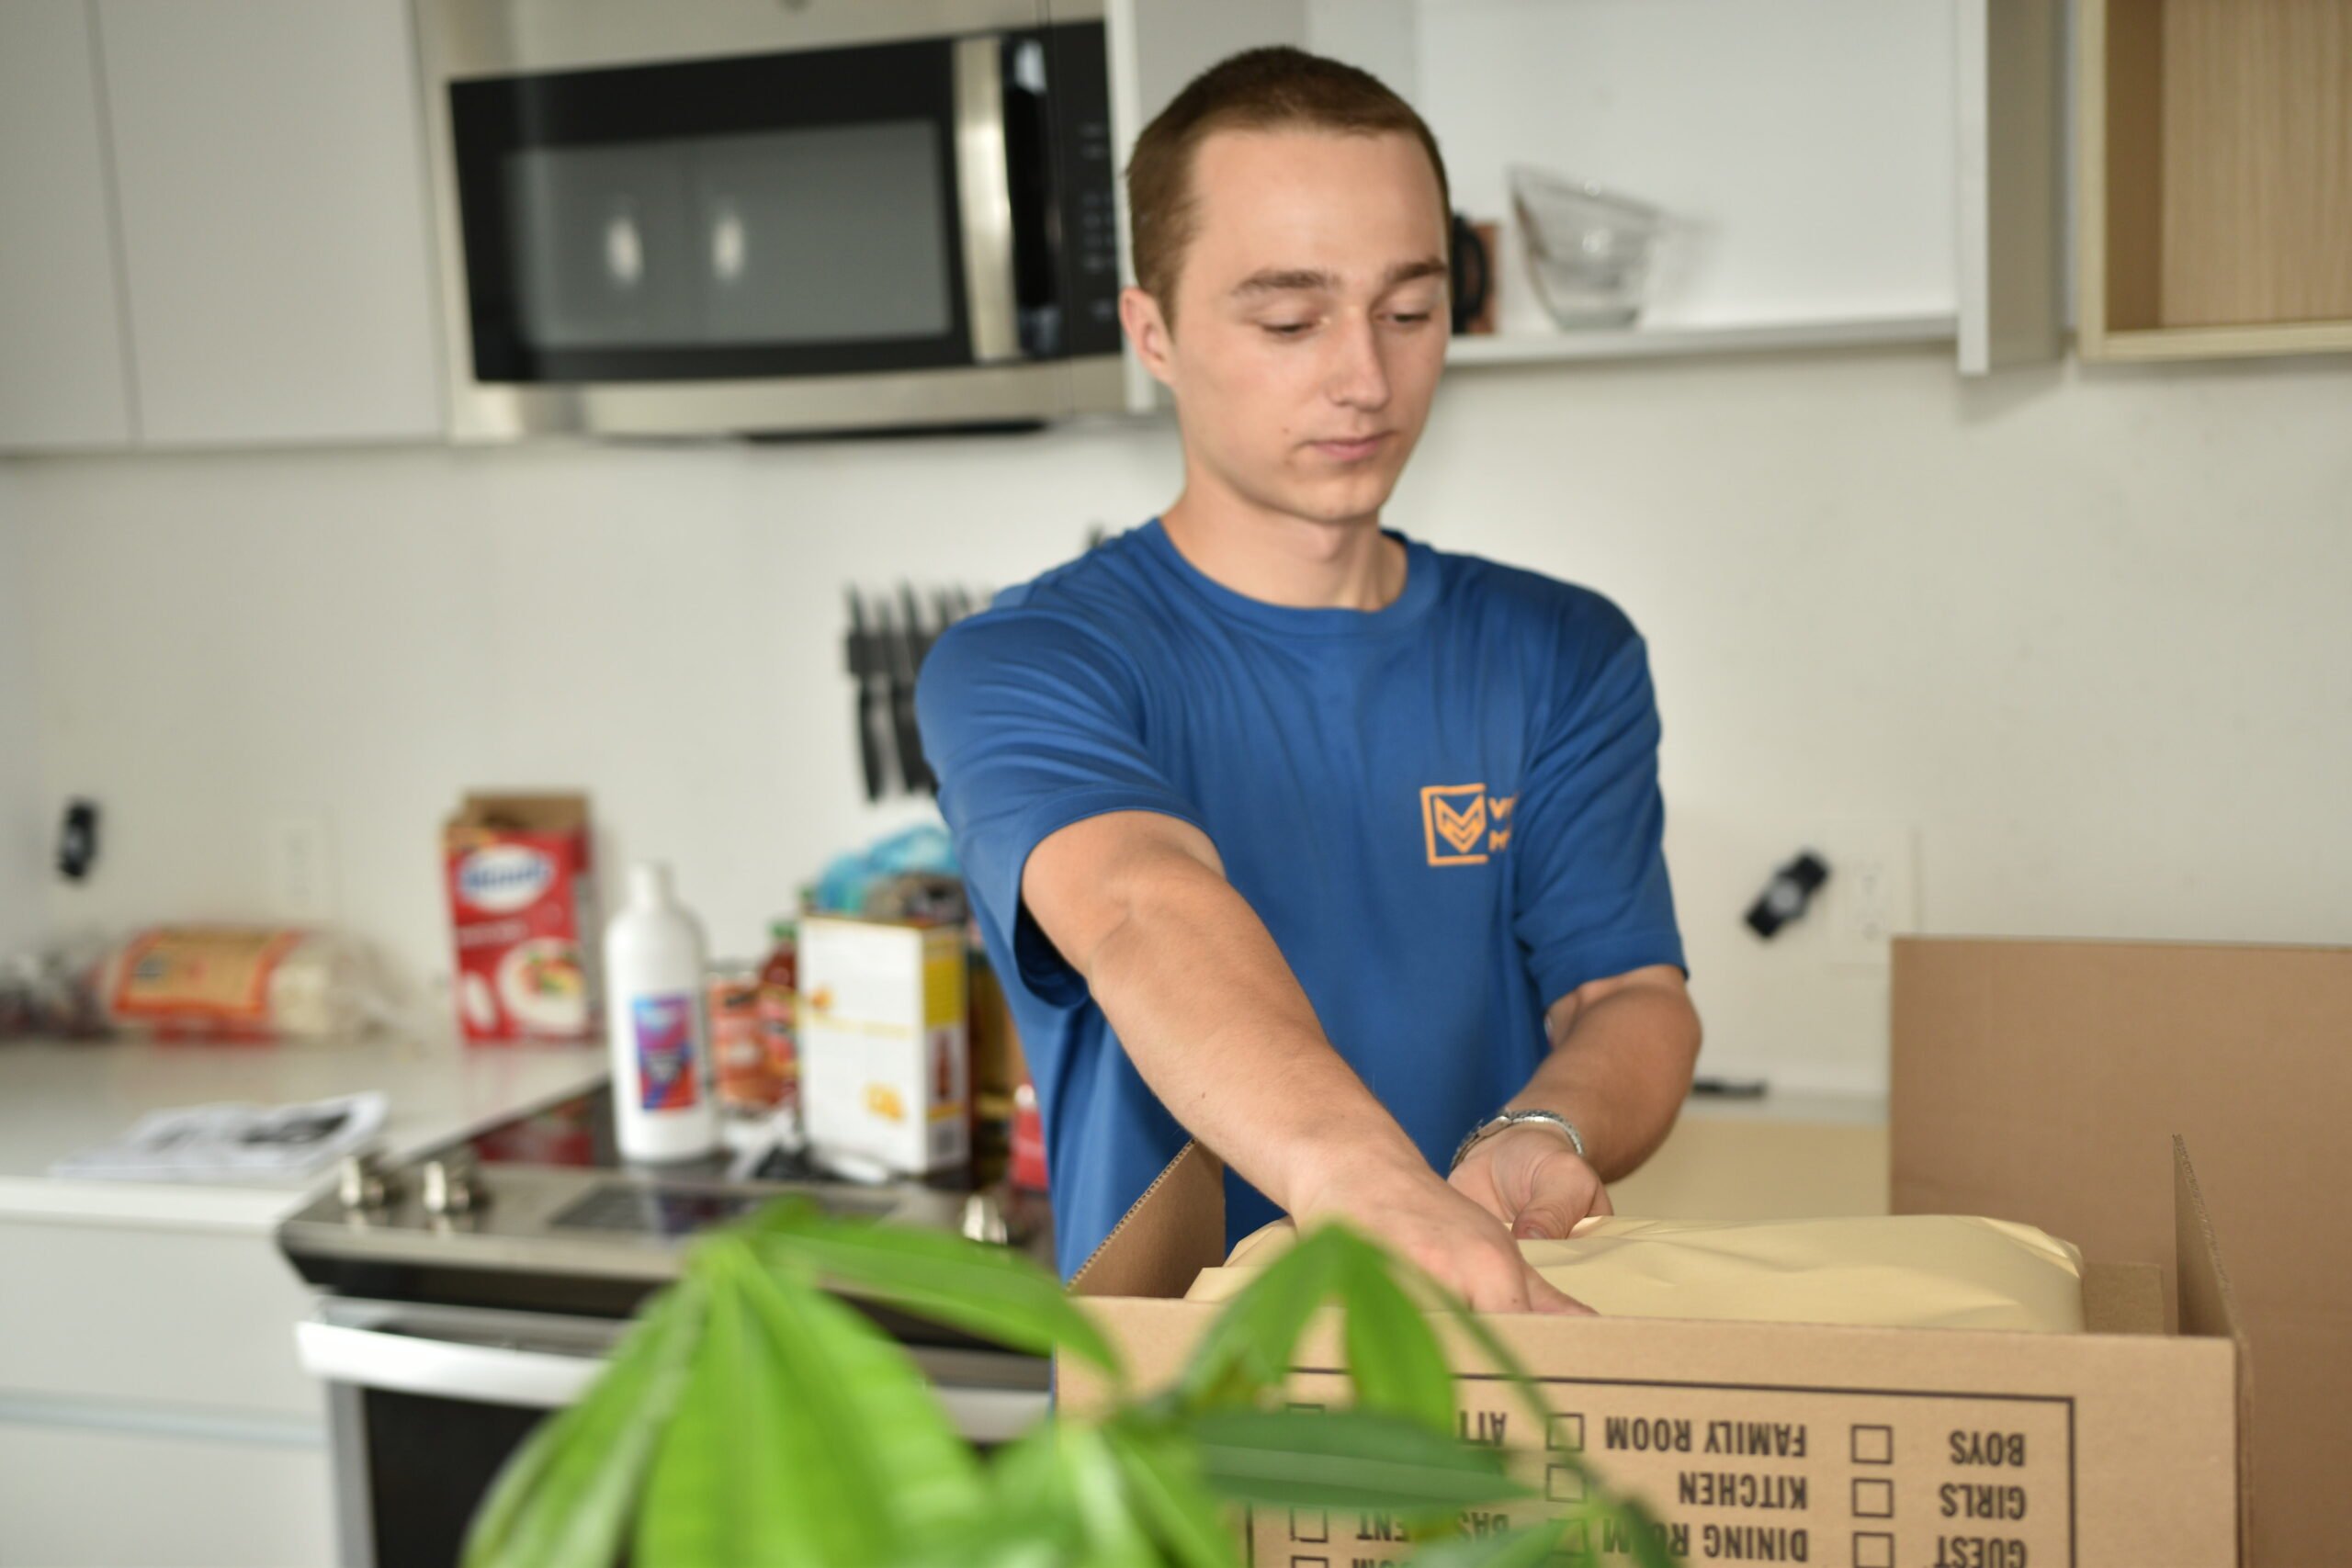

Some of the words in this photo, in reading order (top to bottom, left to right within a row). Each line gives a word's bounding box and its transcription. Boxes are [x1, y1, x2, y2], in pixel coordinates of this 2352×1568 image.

[1458, 1412, 1508, 1447] ATT
[1605, 1416, 1691, 1452] ROOM
[1704, 1420, 1807, 1458] FAMILY
[1948, 1429, 2026, 1467] BOYS
[1678, 1472, 1807, 1509] KITCHEN
[1939, 1482, 2027, 1520] GIRLS
[1703, 1523, 1808, 1562] DINING
[1932, 1535, 2028, 1568] GUEST
